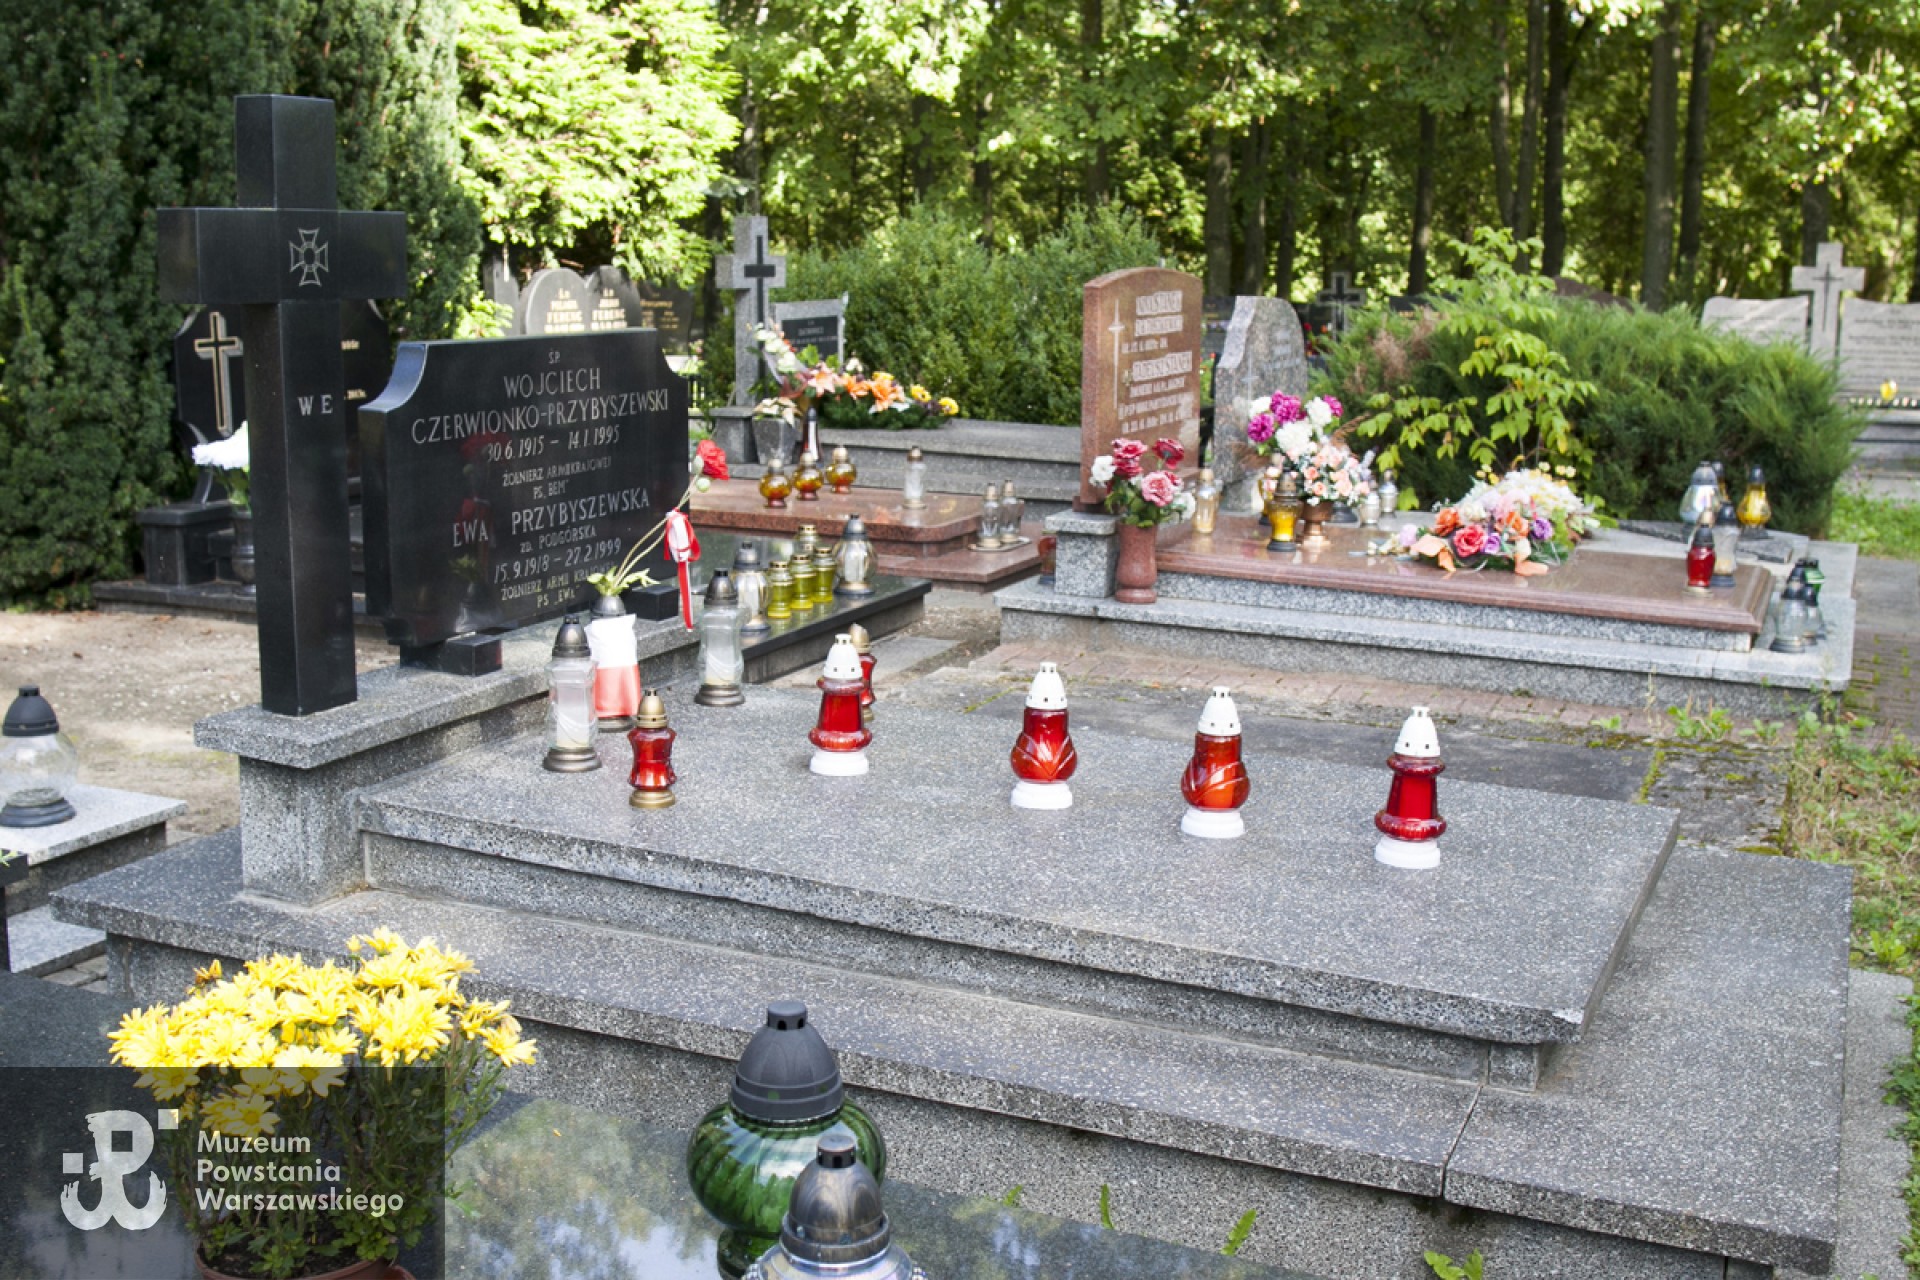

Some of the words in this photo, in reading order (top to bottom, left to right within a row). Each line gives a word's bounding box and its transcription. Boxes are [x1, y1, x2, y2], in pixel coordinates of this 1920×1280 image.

[504, 367, 601, 398] WOJCIECH
[411, 388, 669, 445] CZERWIONKO-PRZYBYSZEWSKI
[453, 519, 489, 548] EWA
[511, 487, 650, 535] PRZYBYSZEWSKA
